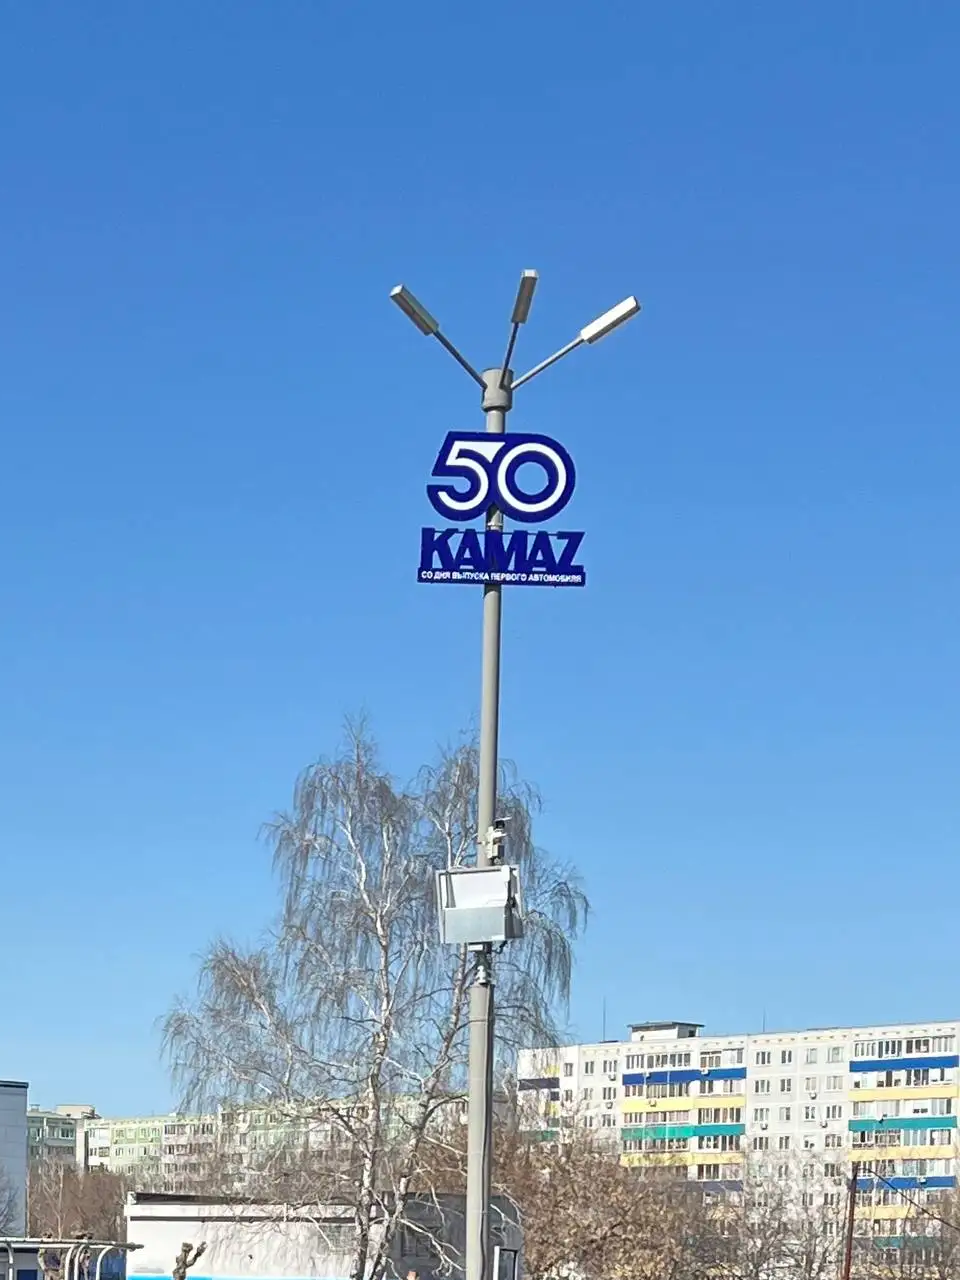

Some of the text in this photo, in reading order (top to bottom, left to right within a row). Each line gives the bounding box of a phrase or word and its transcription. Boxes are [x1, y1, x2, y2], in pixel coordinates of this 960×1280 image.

[437, 440, 567, 513] 50
[420, 527, 586, 573] KAMAZ
[421, 571, 582, 584] СО ДНЯ ВЫПУСКА ПЕРВОГО АВТОМОБИЛЯ
